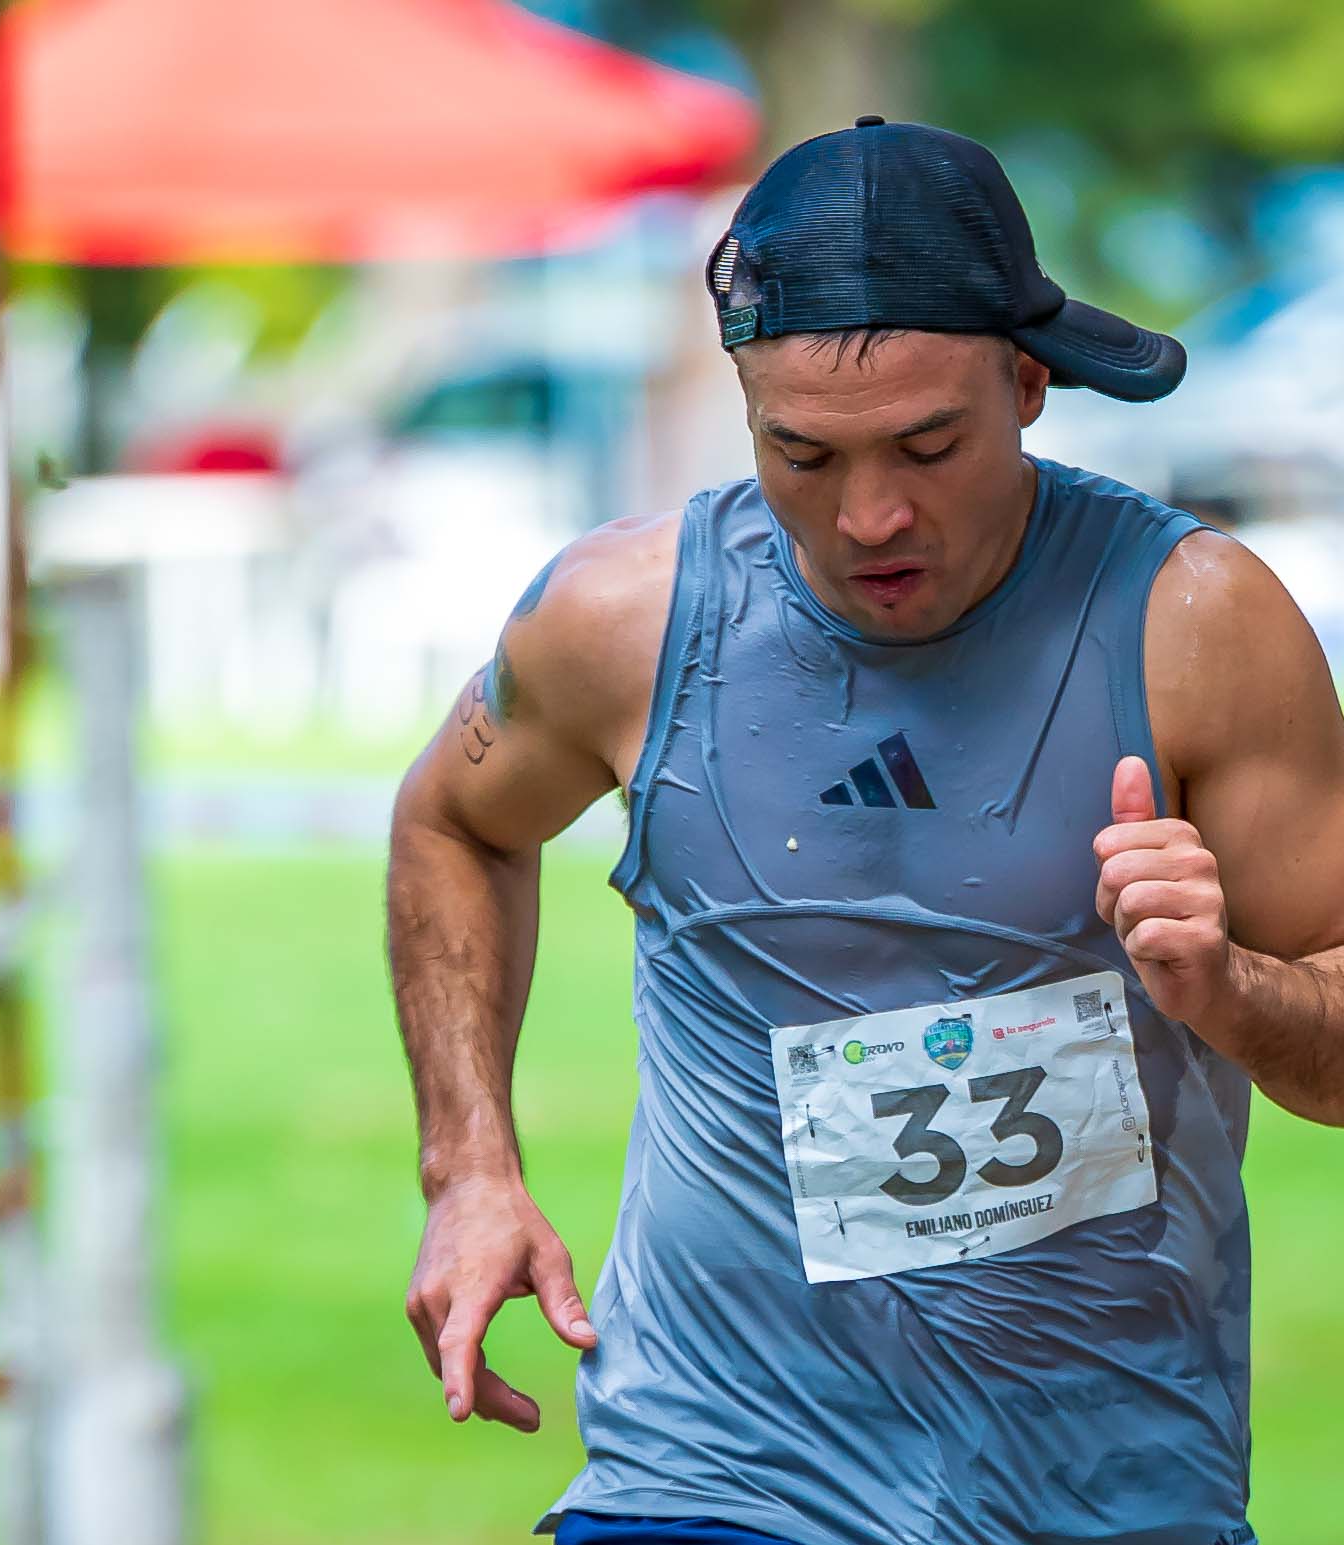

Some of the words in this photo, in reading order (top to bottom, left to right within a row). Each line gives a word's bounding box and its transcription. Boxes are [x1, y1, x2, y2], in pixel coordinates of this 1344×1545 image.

[870, 1065, 1063, 1207] 33
[905, 1213, 972, 1238] EMILIANO
[974, 1194, 1054, 1228] DOMÍNGUEZ
